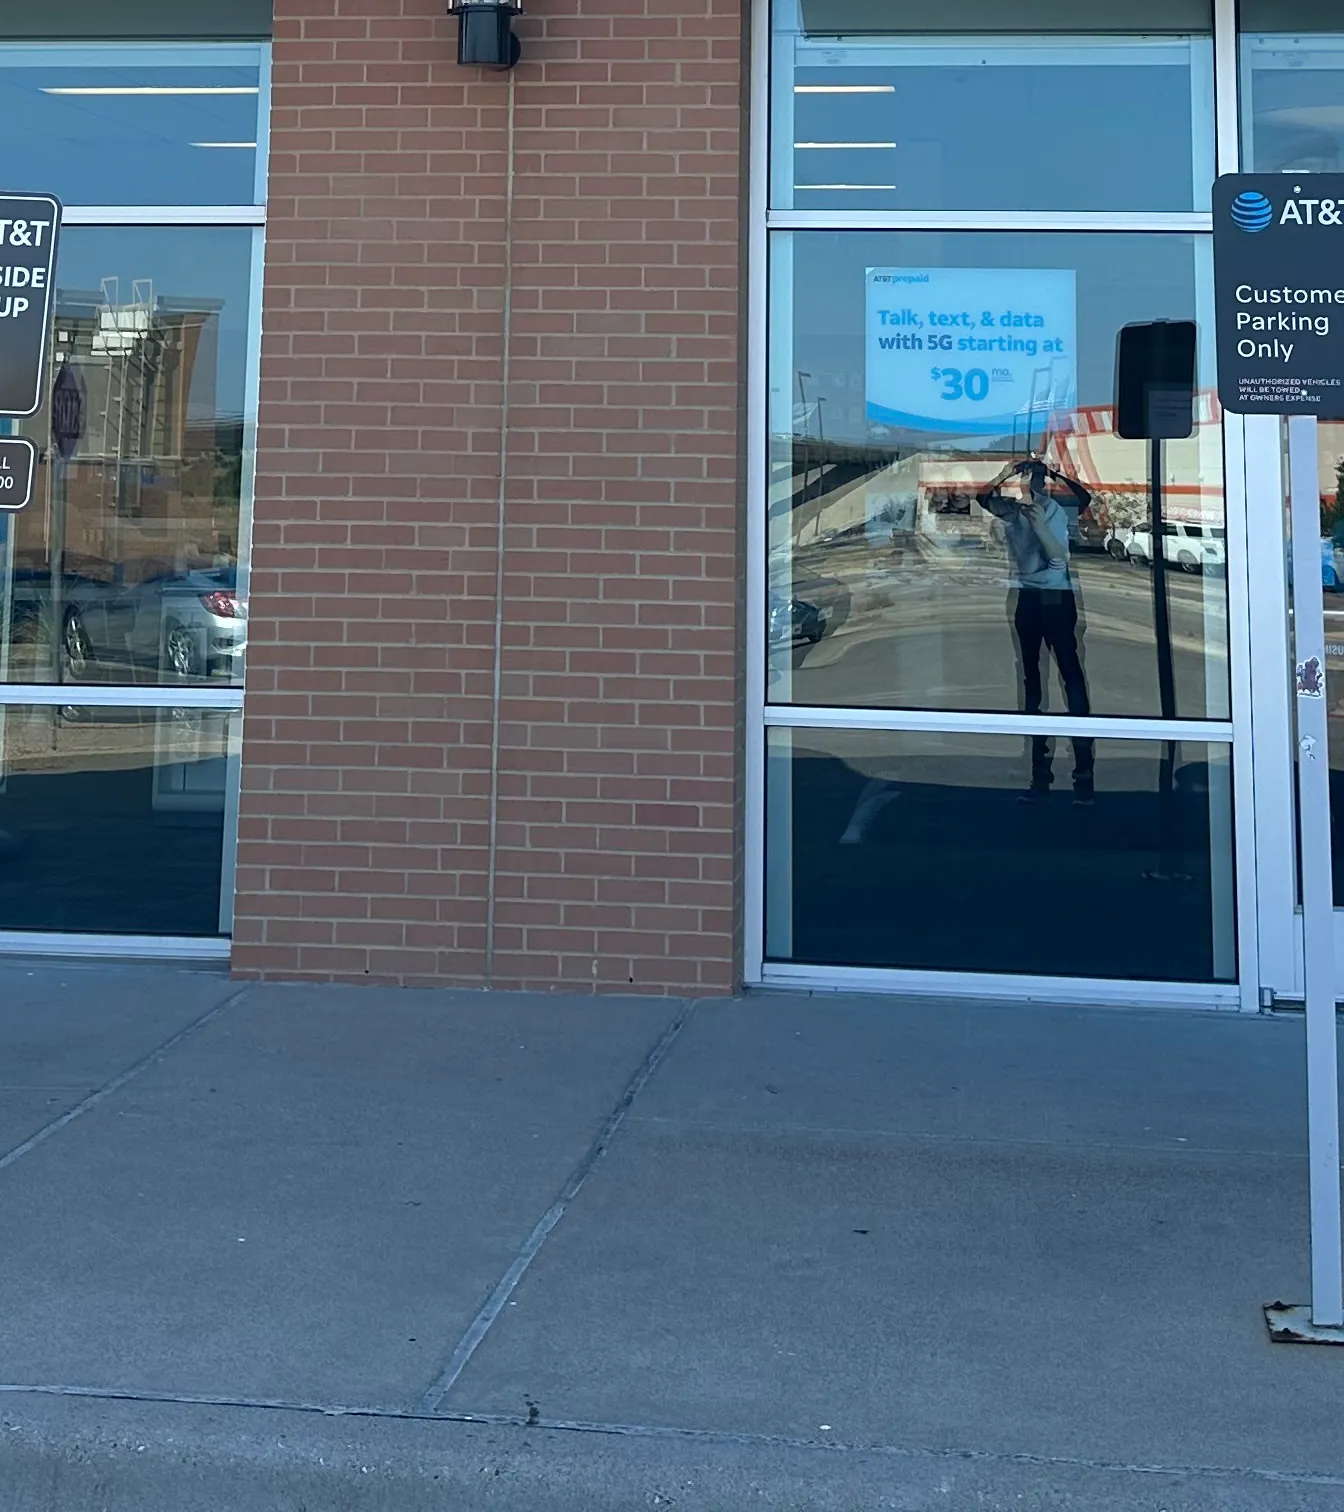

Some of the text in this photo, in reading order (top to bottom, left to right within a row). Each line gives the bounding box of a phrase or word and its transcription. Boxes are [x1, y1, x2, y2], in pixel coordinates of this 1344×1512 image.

[877, 309, 1044, 329] Talk, text, & data
[1236, 312, 1330, 335] Parking
[878, 333, 1064, 356] with 5G starting at
[1237, 339, 1294, 363] Only
[930, 366, 990, 402] $30
[1238, 378, 1341, 386] UNAUTHORIZED VEHICLES
